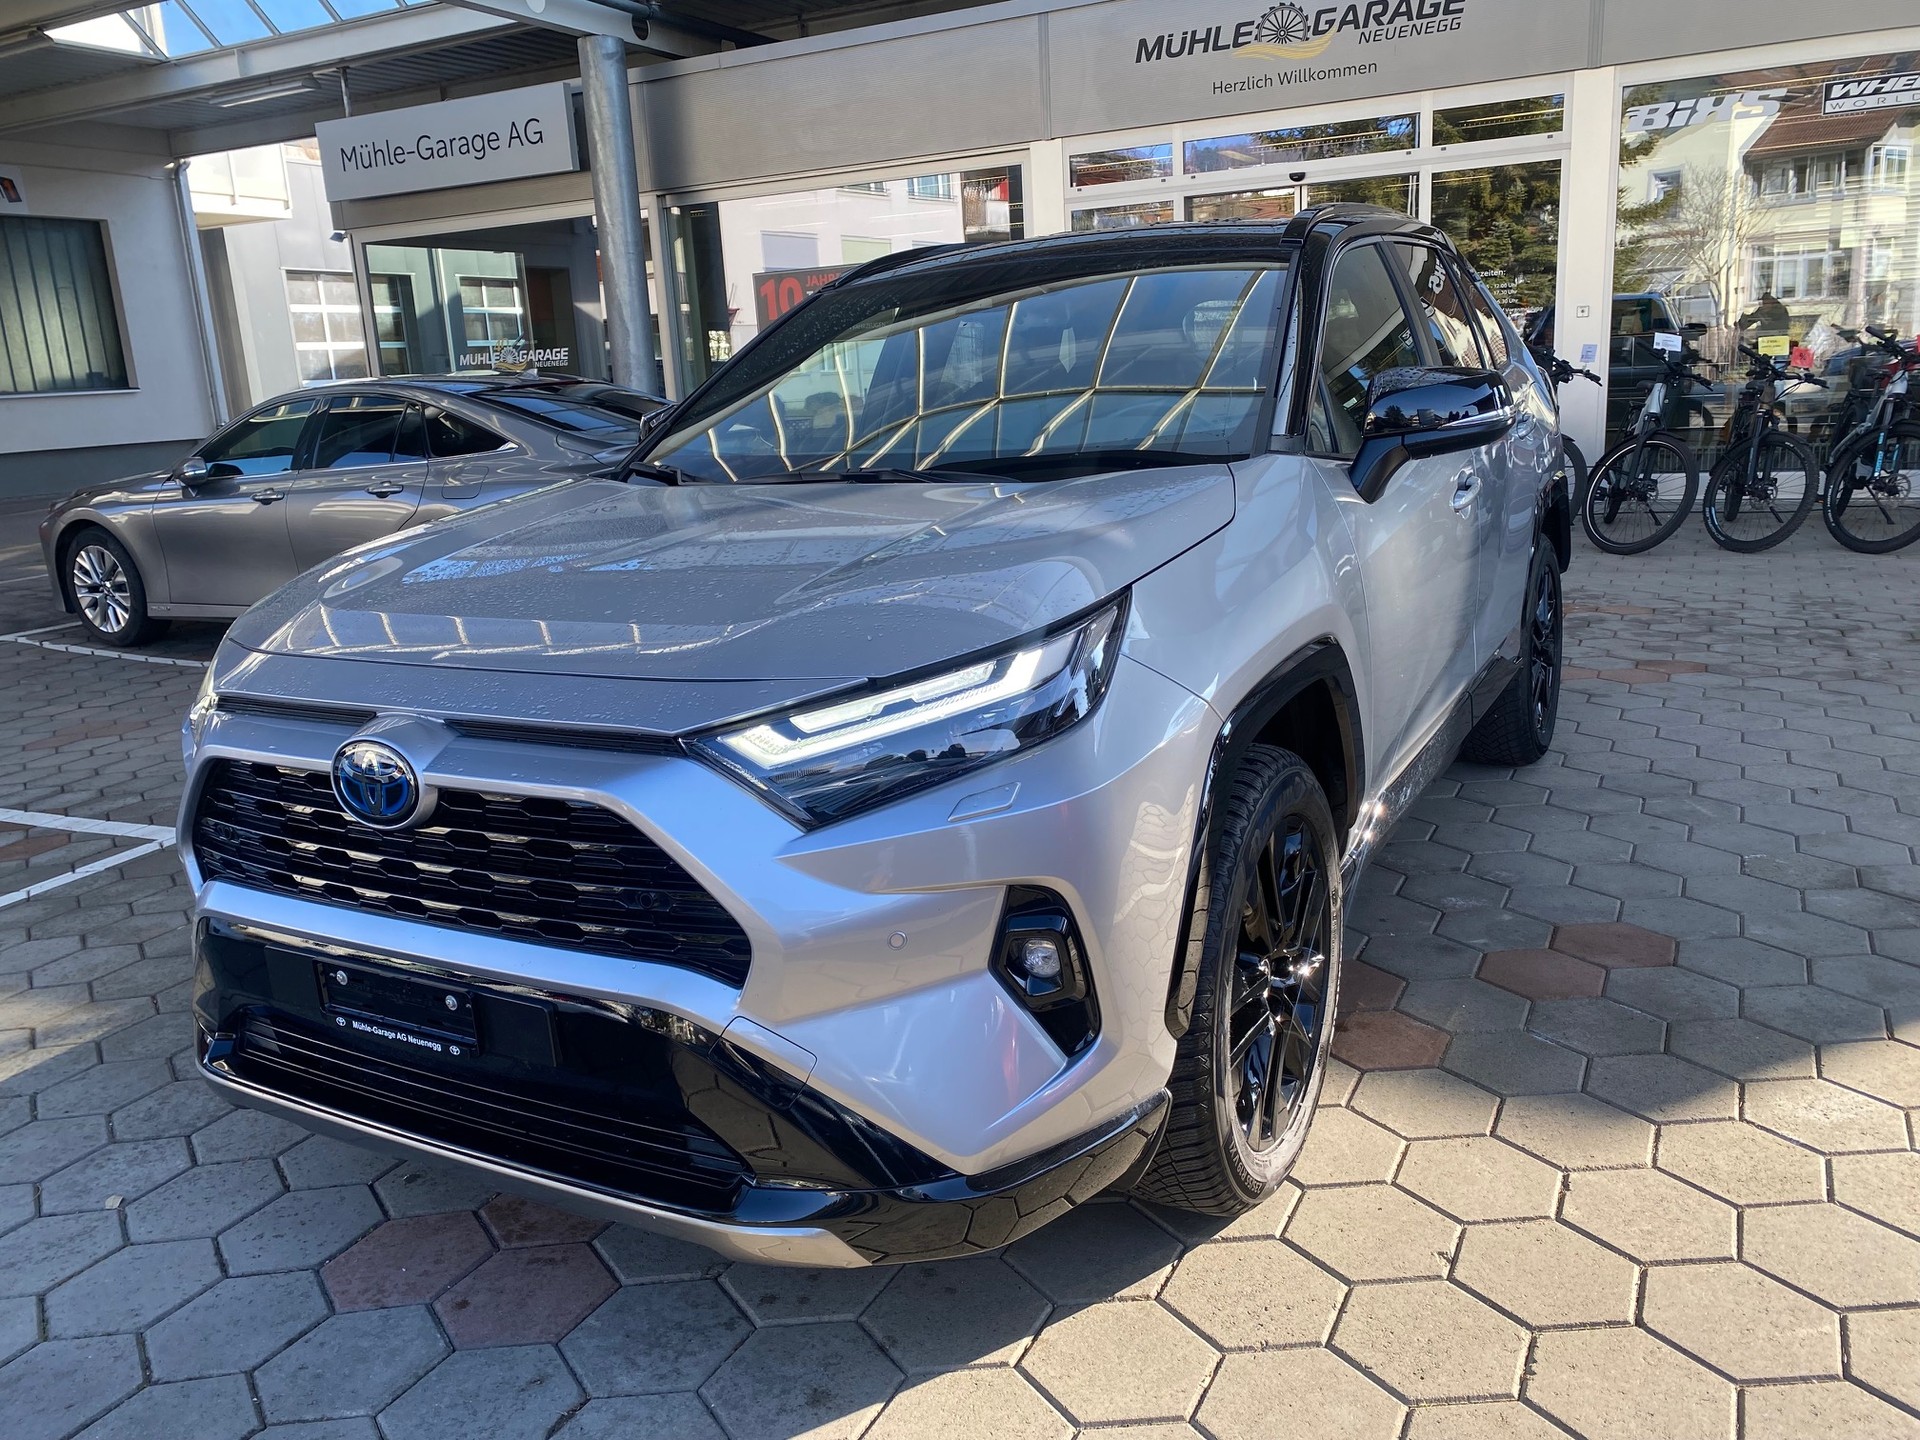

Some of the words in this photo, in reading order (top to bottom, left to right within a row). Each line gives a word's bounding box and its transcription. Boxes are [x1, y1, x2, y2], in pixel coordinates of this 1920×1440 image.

[1135, 20, 1255, 63] MÜHLE
[1312, 0, 1466, 36] GARAGE
[1358, 16, 1463, 45] NEUENEGG
[1212, 73, 1274, 95] Herzlich
[1278, 61, 1378, 85] Willkommen
[340, 131, 500, 172] Mühle-Garage
[508, 118, 544, 148] AG
[760, 276, 803, 321] 10
[519, 348, 569, 362] GARAGE
[352, 1020, 396, 1039] Mühle-Garage
[396, 1031, 408, 1042] AG
[407, 1034, 442, 1052] Neuenegg
